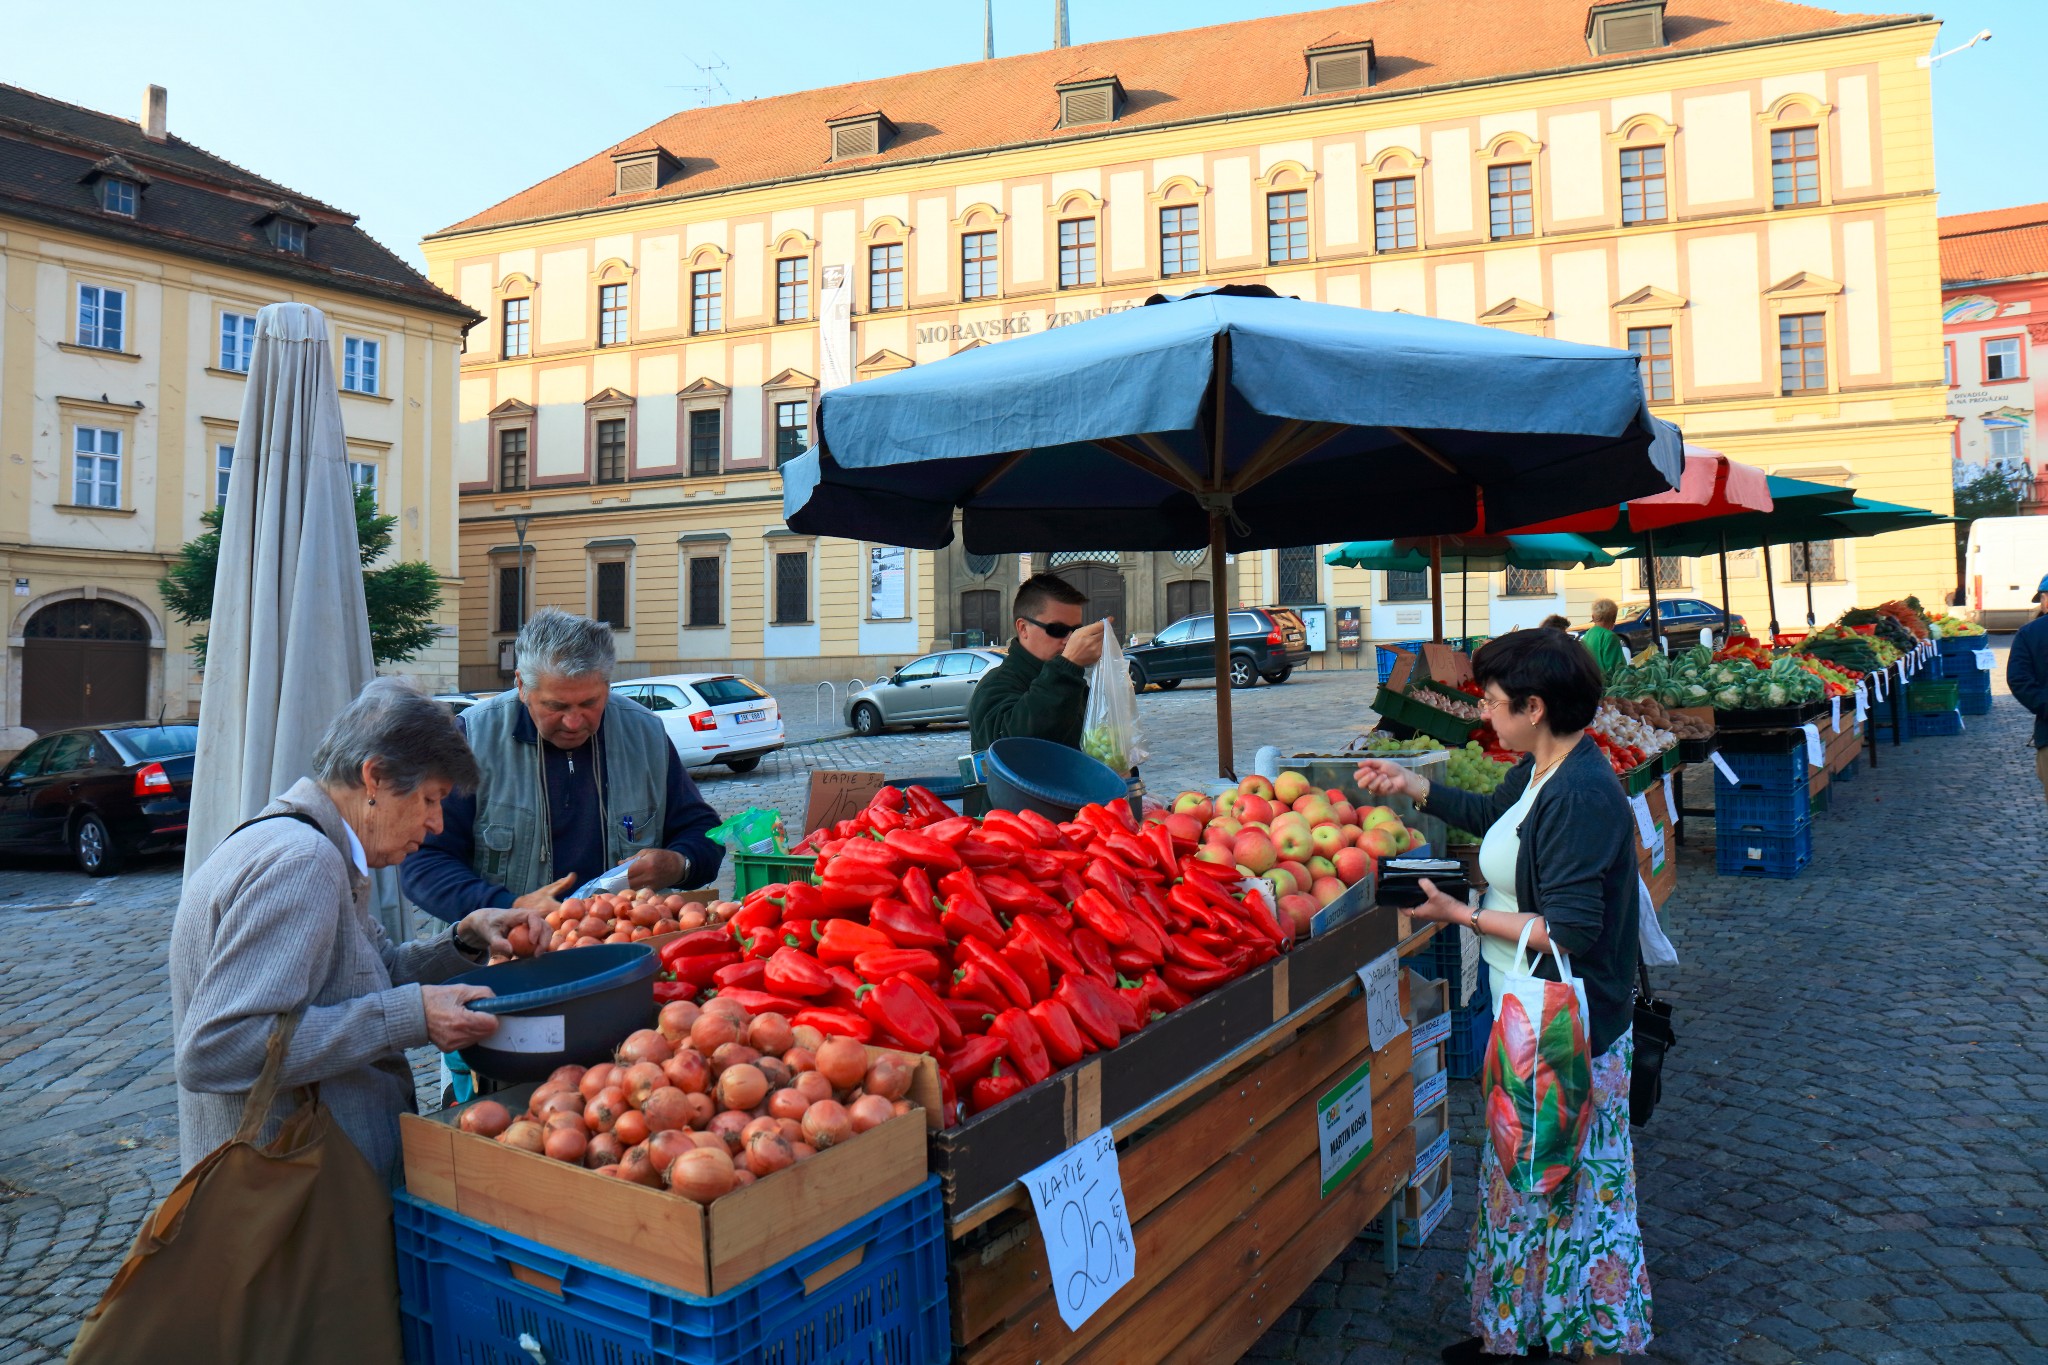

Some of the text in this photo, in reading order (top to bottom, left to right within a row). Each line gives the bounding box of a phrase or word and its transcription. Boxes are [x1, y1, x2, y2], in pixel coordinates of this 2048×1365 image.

[916, 312, 1031, 344] MORAVSKÉ
[1954, 391, 1988, 399] DIVADLO
[822, 773, 858, 785] KAPIE
[1330, 1126, 1351, 1157] MARTIN
[1350, 1110, 1367, 1137] KOSÍK
[1038, 1157, 1087, 1209] KAPIE
